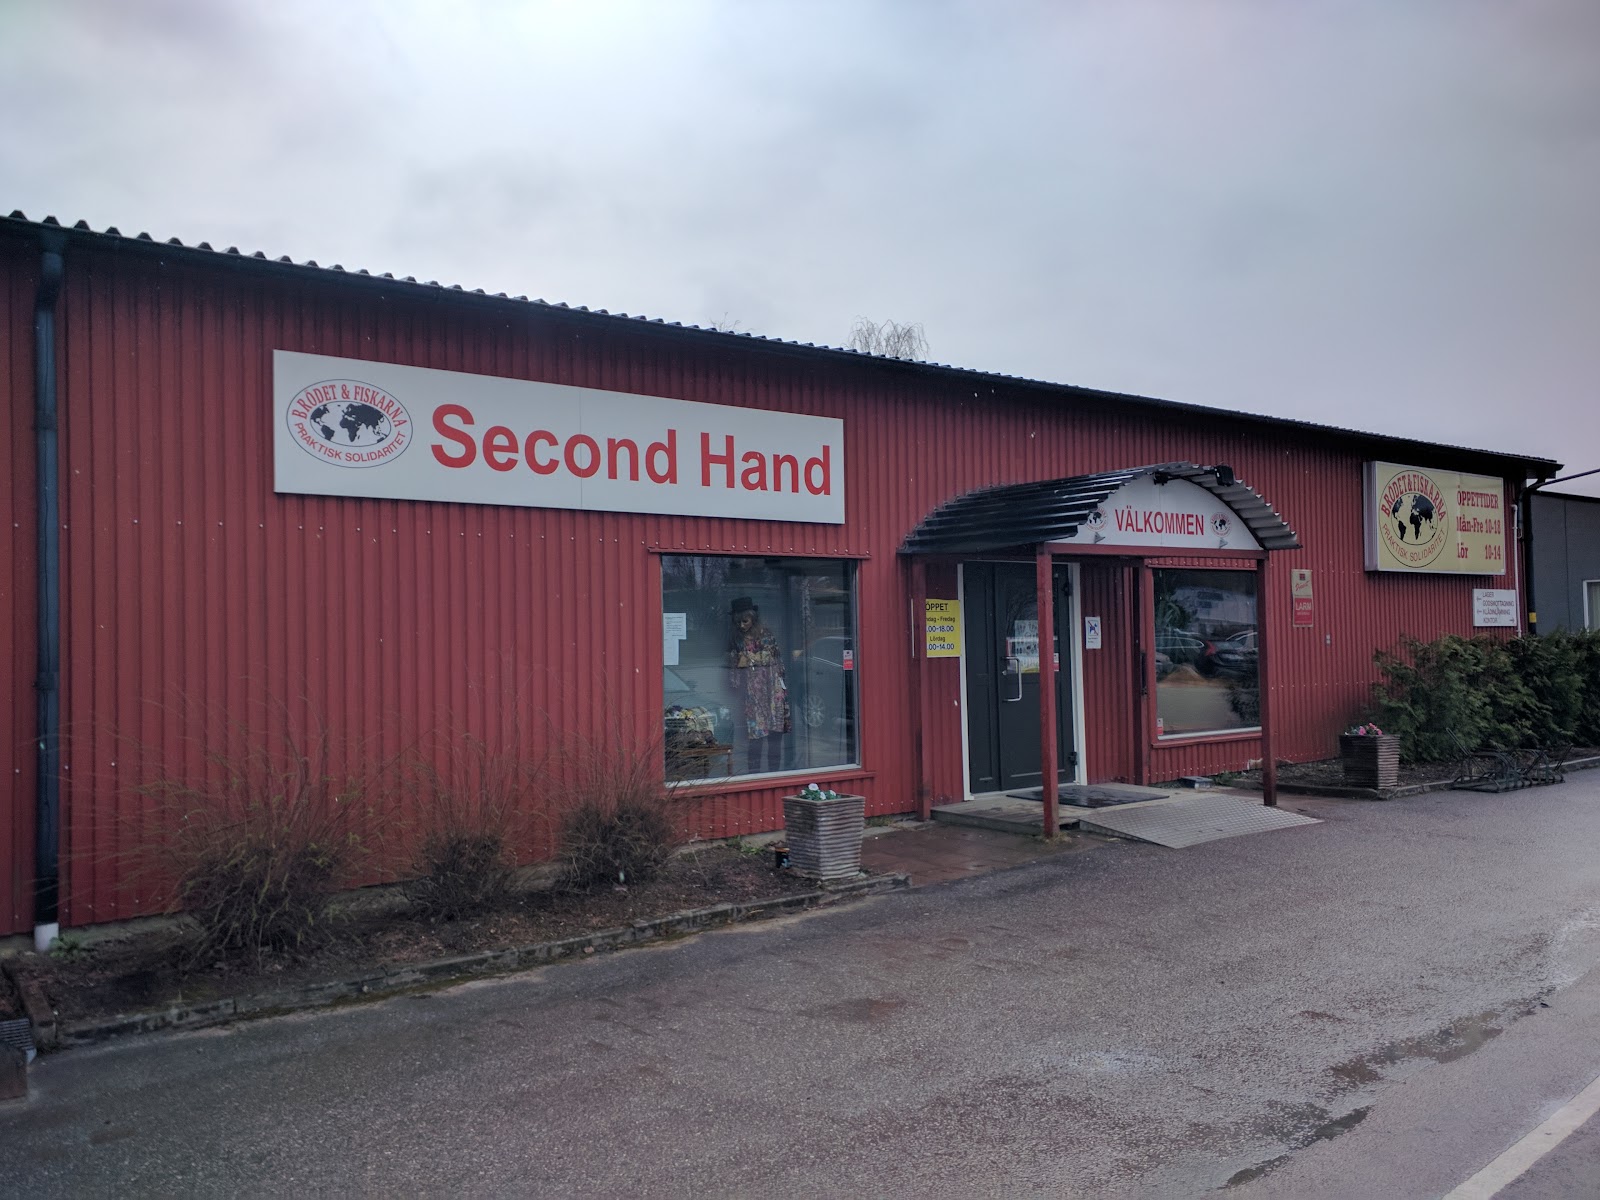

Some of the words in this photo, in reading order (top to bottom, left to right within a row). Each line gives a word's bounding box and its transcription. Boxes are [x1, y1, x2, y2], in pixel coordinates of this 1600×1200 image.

[291, 384, 337, 420] BRÖDET
[341, 384, 350, 399] &
[354, 385, 408, 428] FISKARNA
[294, 422, 342, 460] PRAKTISK
[345, 430, 406, 462] SOLIDARITET
[431, 403, 677, 485] Second
[700, 432, 831, 496] Hand
[1456, 485, 1499, 510] ÖPPETTIDER
[1115, 505, 1205, 536] VÄLKOMMEN
[1382, 523, 1409, 560] PRAKTISK
[1409, 529, 1445, 562] SOLIDARITET
[1485, 544, 1501, 560] 10-14
